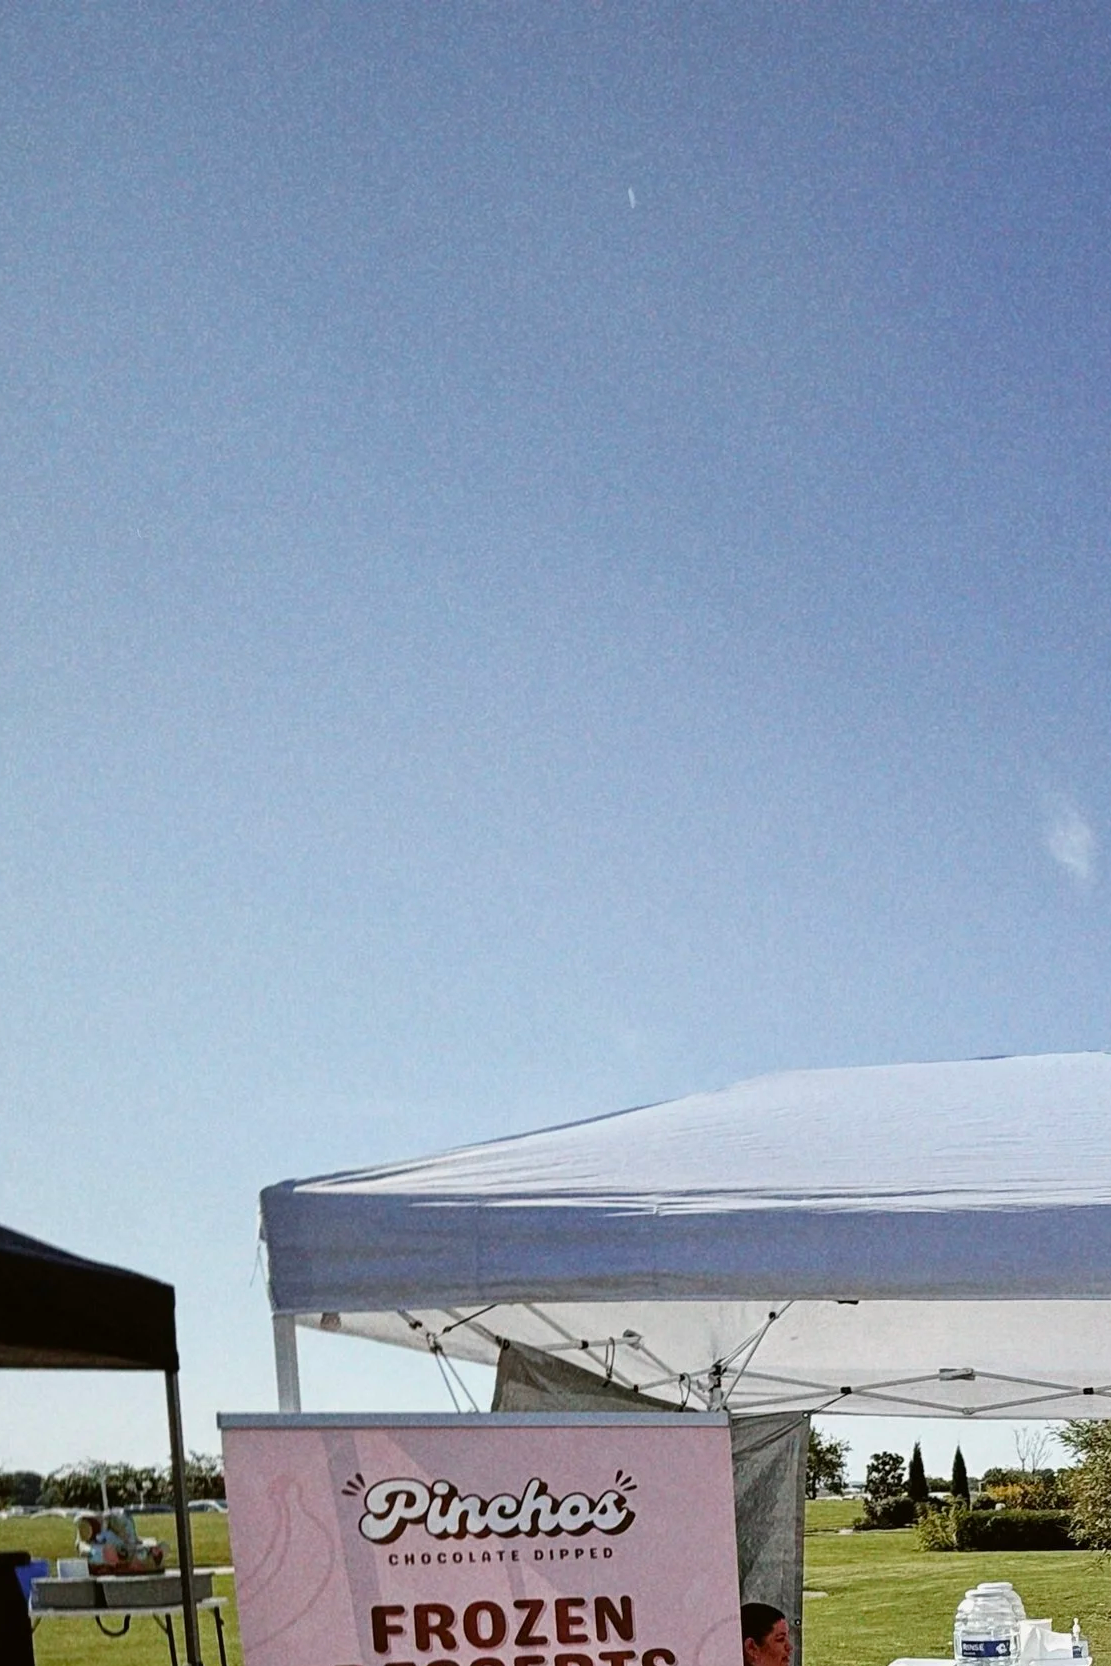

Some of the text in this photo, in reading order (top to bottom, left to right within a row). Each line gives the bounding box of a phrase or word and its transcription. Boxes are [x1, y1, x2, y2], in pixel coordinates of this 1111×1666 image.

[359, 1477, 635, 1545] Pinchos
[388, 1546, 614, 1567] CHOCOLATE DIPPED
[371, 1595, 636, 1654] FROZEN
[962, 1642, 985, 1653] RINSE
